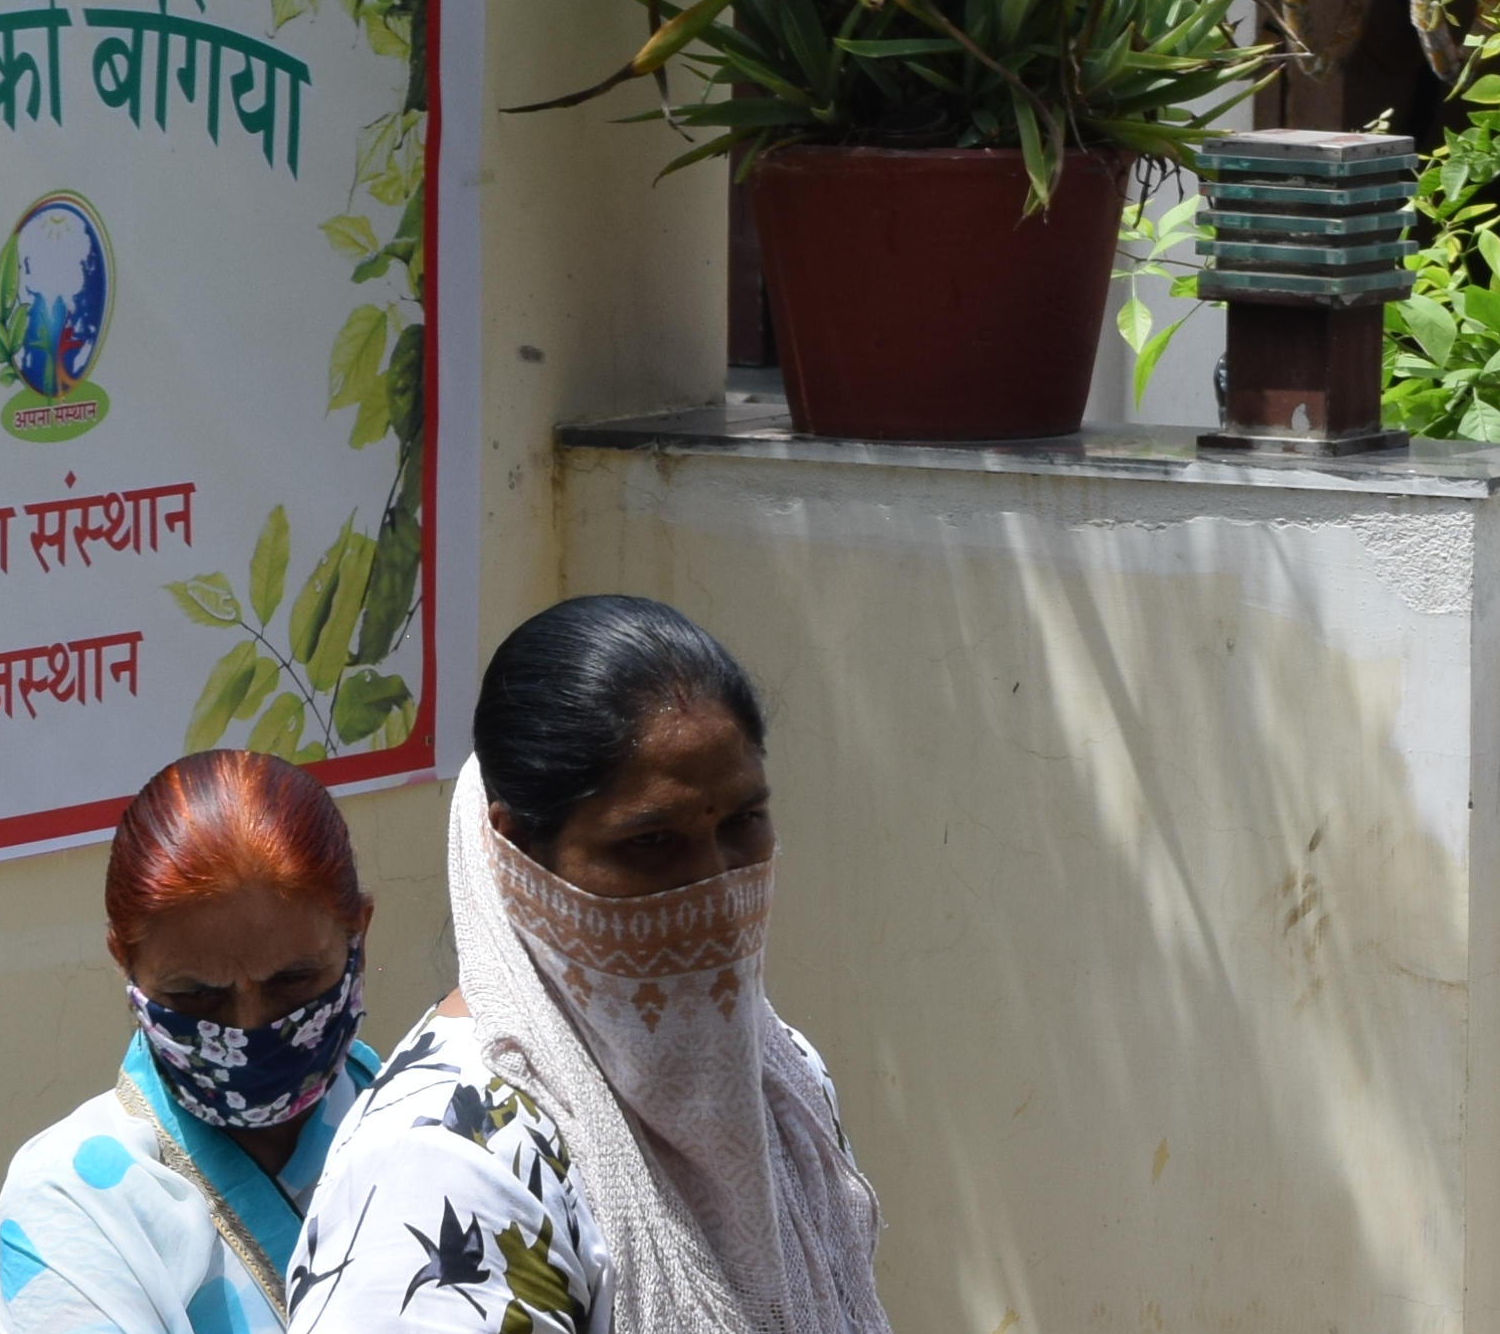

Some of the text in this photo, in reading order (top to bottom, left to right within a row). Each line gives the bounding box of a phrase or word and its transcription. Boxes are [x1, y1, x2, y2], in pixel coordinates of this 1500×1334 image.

[14, 398, 97, 429] अपना संस्थान
[24, 471, 196, 574] संस्थान
